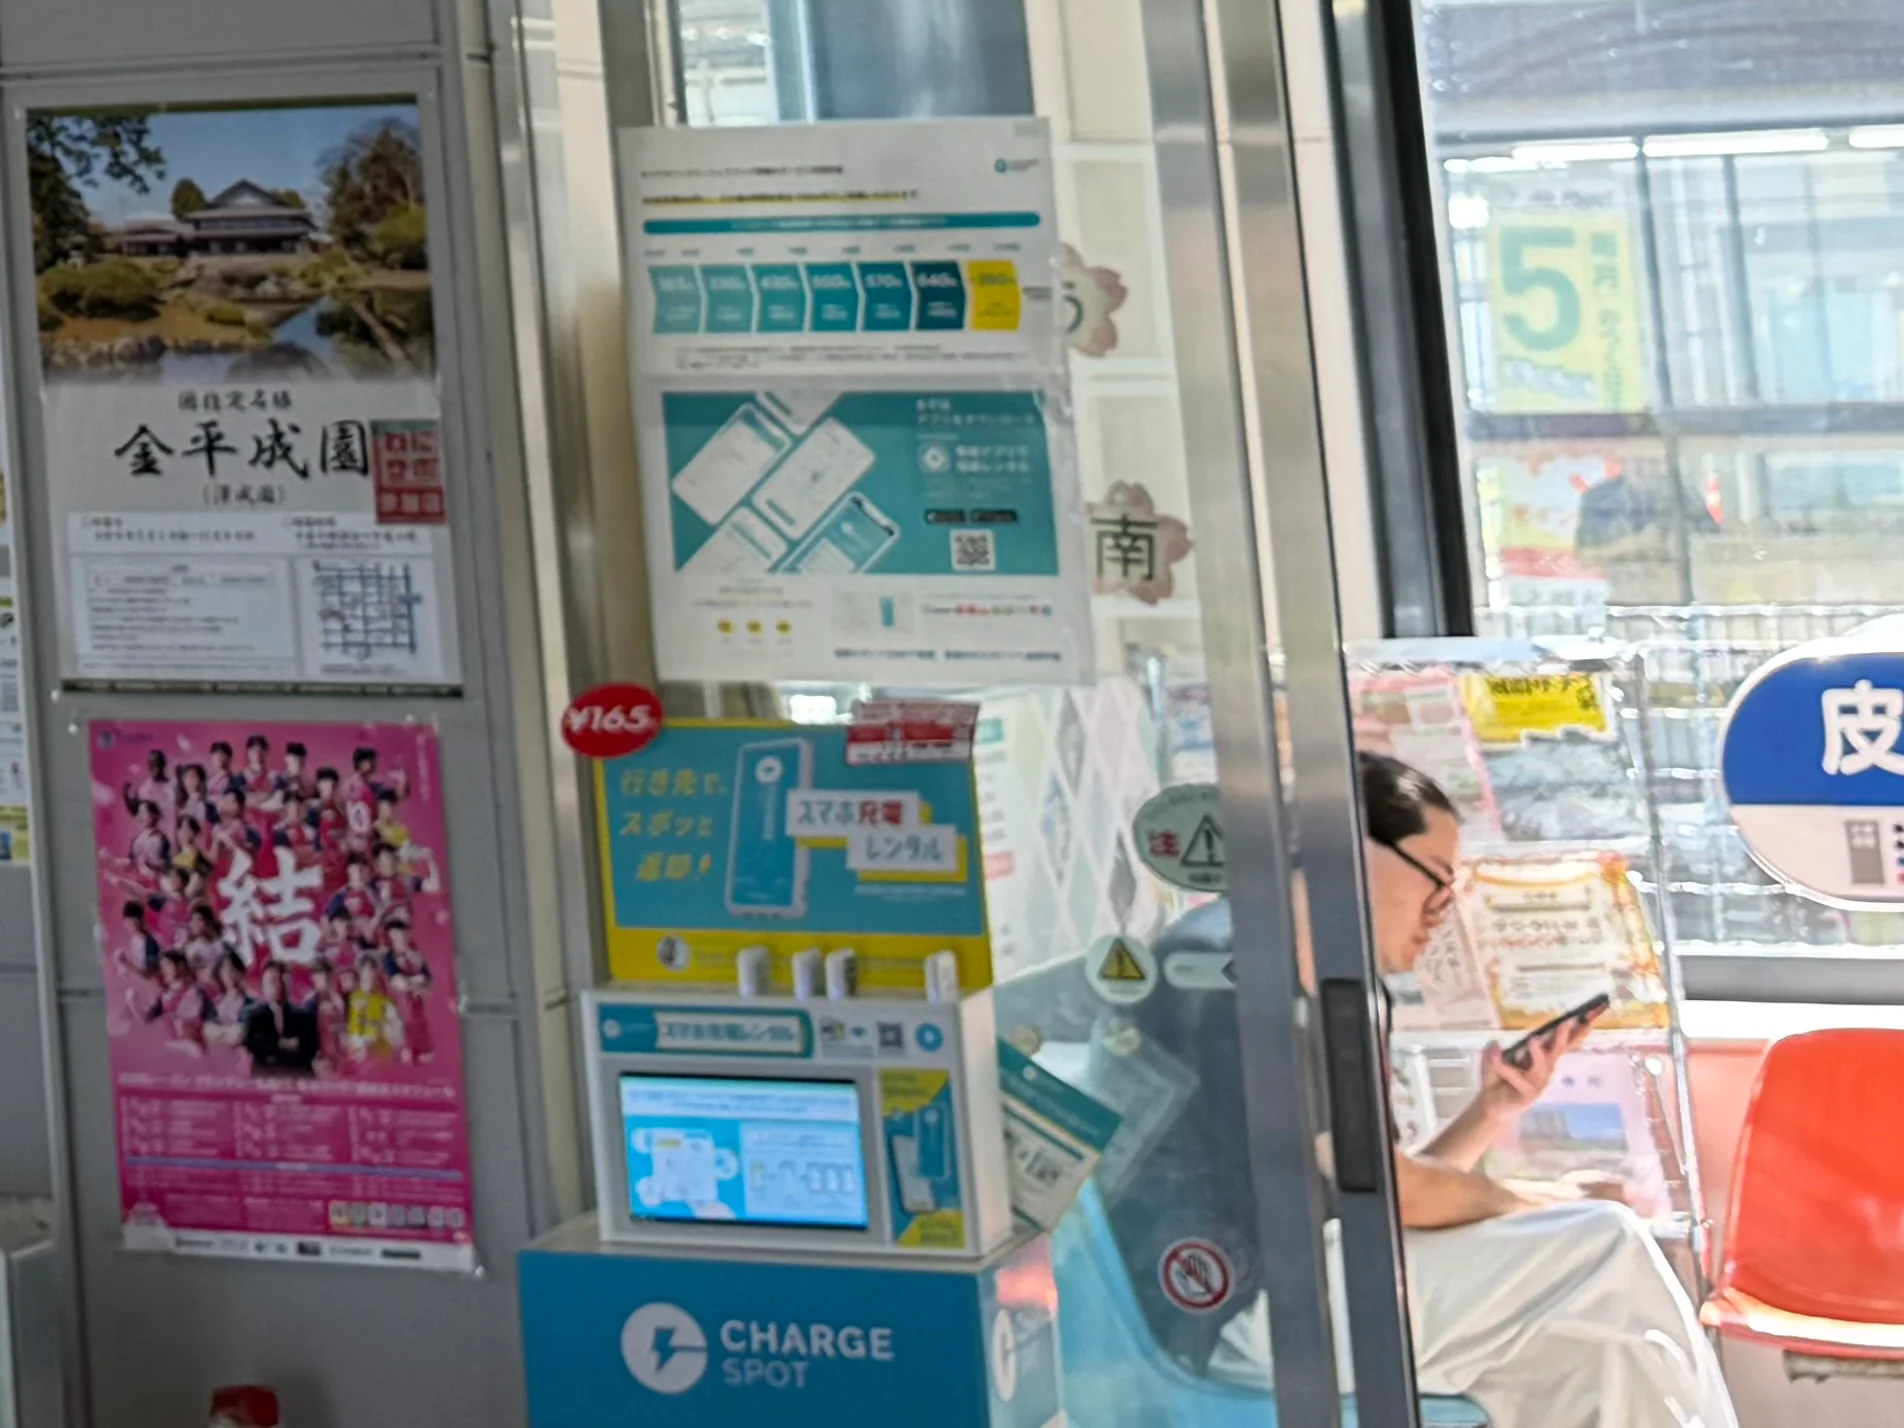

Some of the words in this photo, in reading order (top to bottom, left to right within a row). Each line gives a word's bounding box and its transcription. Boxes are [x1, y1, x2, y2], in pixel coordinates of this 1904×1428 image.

[1499, 225, 1582, 355] 5
[113, 418, 370, 479] 金平成園
[1088, 512, 1158, 582] 南
[567, 704, 651, 733] ¥165
[1820, 678, 1904, 776] 皮
[797, 800, 905, 830] スマホ充電
[865, 835, 945, 862] レンタル
[214, 845, 327, 972] 結
[719, 1317, 894, 1361] CHARGE
[722, 1359, 810, 1389] SPOT
